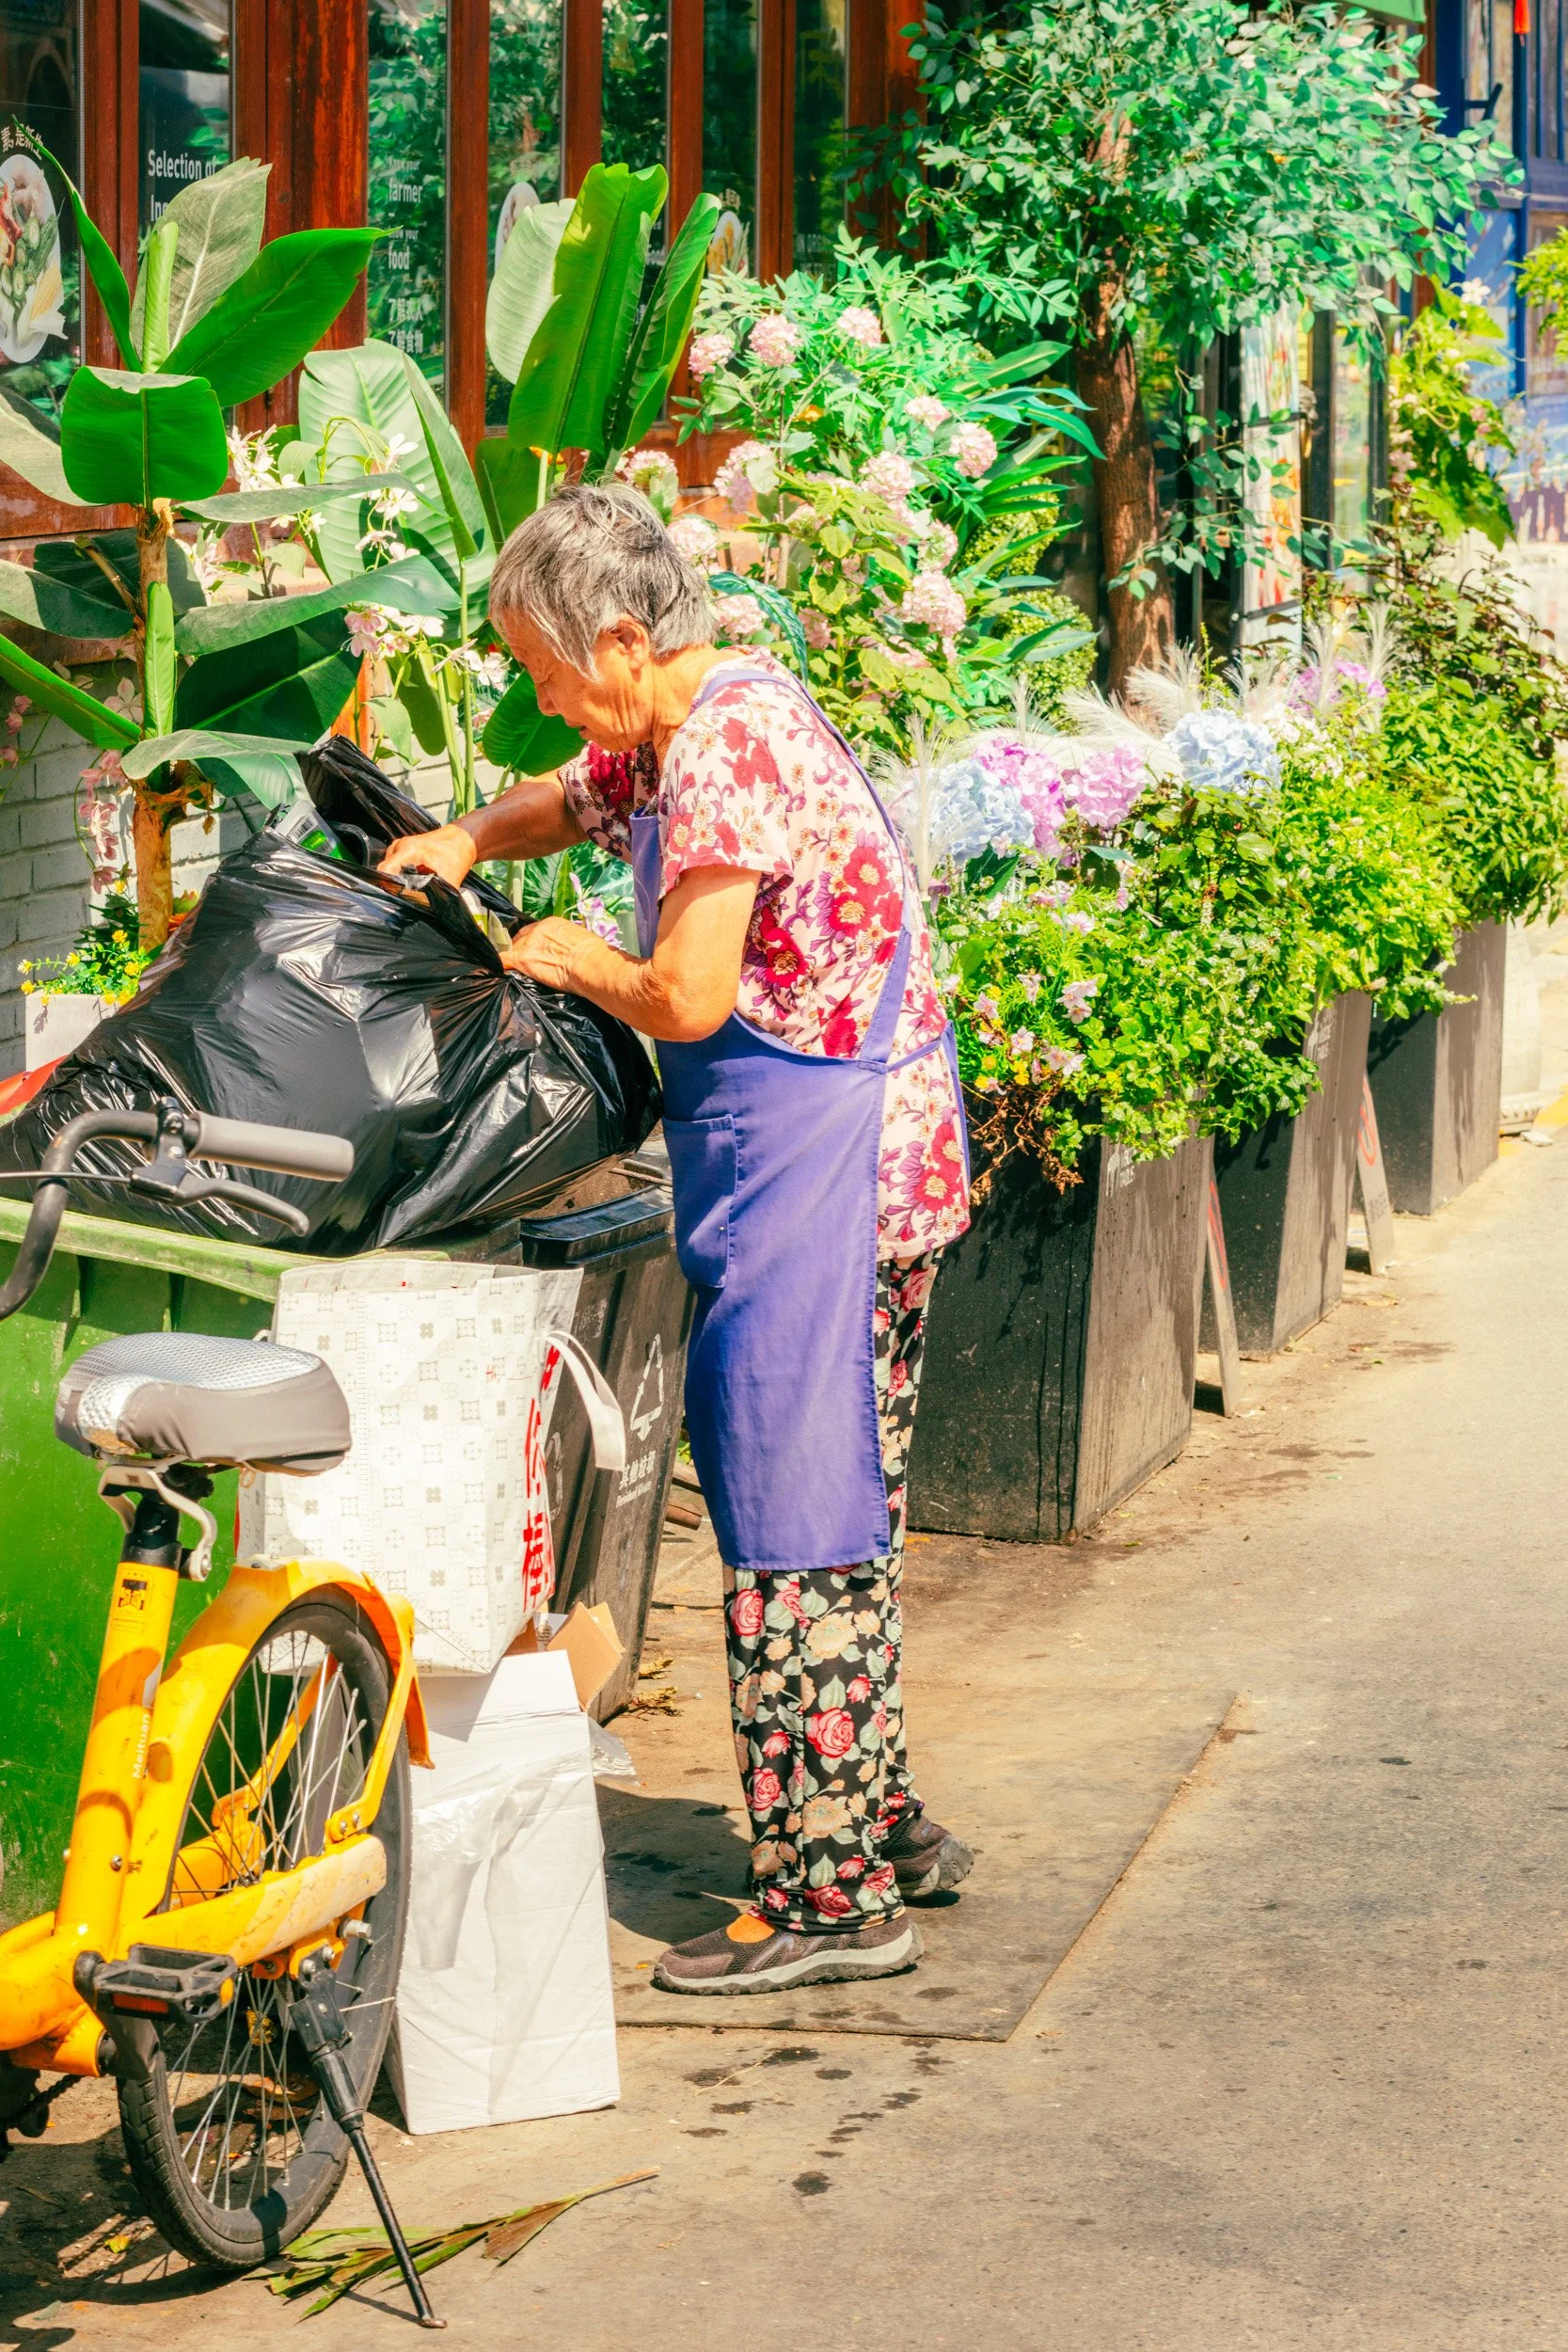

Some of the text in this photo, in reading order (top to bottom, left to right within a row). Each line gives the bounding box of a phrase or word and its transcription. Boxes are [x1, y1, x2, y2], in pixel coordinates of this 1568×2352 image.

[148, 149, 217, 180] Selection of
[388, 177, 423, 203] farmer
[405, 230, 419, 243] your
[388, 240, 409, 270] food
[619, 1450, 656, 1490] 其他垃圾
[133, 1714, 150, 1780] Meituan
